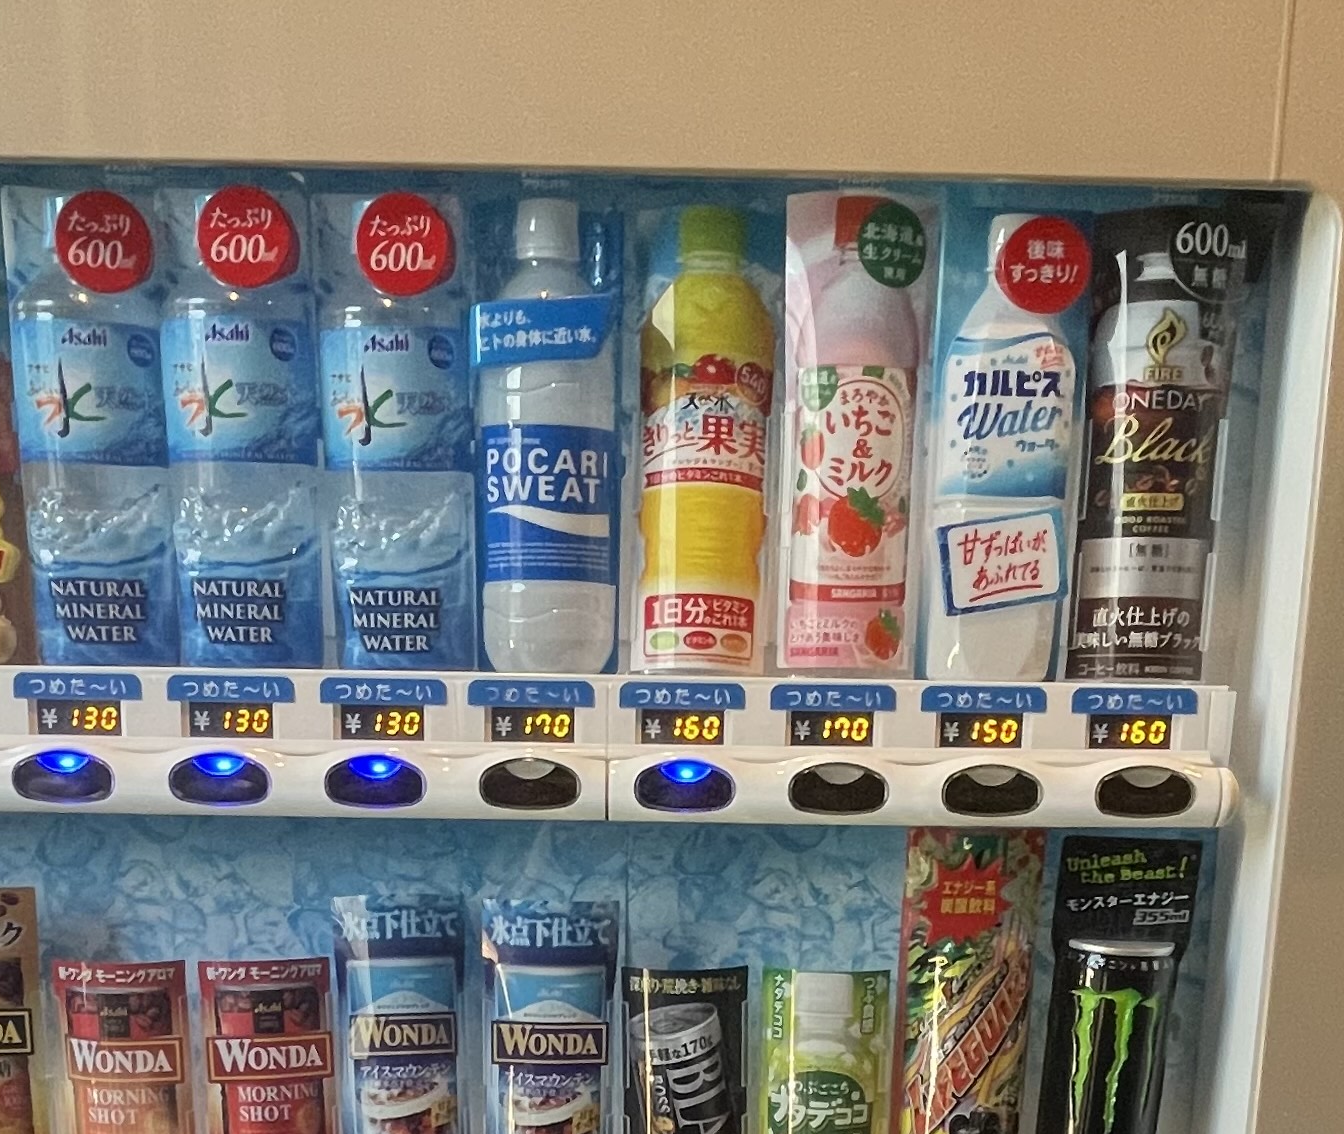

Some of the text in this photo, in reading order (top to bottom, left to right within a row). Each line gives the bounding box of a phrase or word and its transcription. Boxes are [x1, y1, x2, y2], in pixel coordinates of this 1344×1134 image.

[67, 212, 132, 235] たっぷり
[210, 207, 272, 230] たっぷり
[61, 326, 108, 348] Asahi
[205, 324, 250, 344] Asahi
[963, 369, 1062, 399] カルピス
[1143, 367, 1184, 382] FIRE
[825, 405, 897, 437] いちご
[957, 400, 1064, 440] Water
[485, 448, 608, 479] POCARI
[828, 456, 894, 486] ミルク
[485, 474, 601, 504] SWEAT
[51, 579, 146, 598] NATURAL
[193, 580, 284, 599] NATURAL
[350, 589, 441, 608] NATURAL
[55, 602, 146, 620] MINERAL
[195, 603, 284, 621] MINERAL
[352, 612, 440, 630] MINERAL
[1092, 606, 1191, 629] 直火仕上げの
[67, 624, 138, 643] WATER
[207, 625, 273, 644] WATER
[363, 633, 430, 653] WATER
[1080, 867, 1115, 885] the
[358, 1016, 449, 1049] WONDA
[498, 1024, 599, 1057] WONDA
[69, 1038, 173, 1074] WONDA
[215, 1038, 324, 1072] WONDA
[86, 1086, 170, 1107] MORNING
[237, 1082, 319, 1103] MORNING
[88, 1108, 138, 1126] SHOT
[239, 1104, 292, 1122] SHOT
